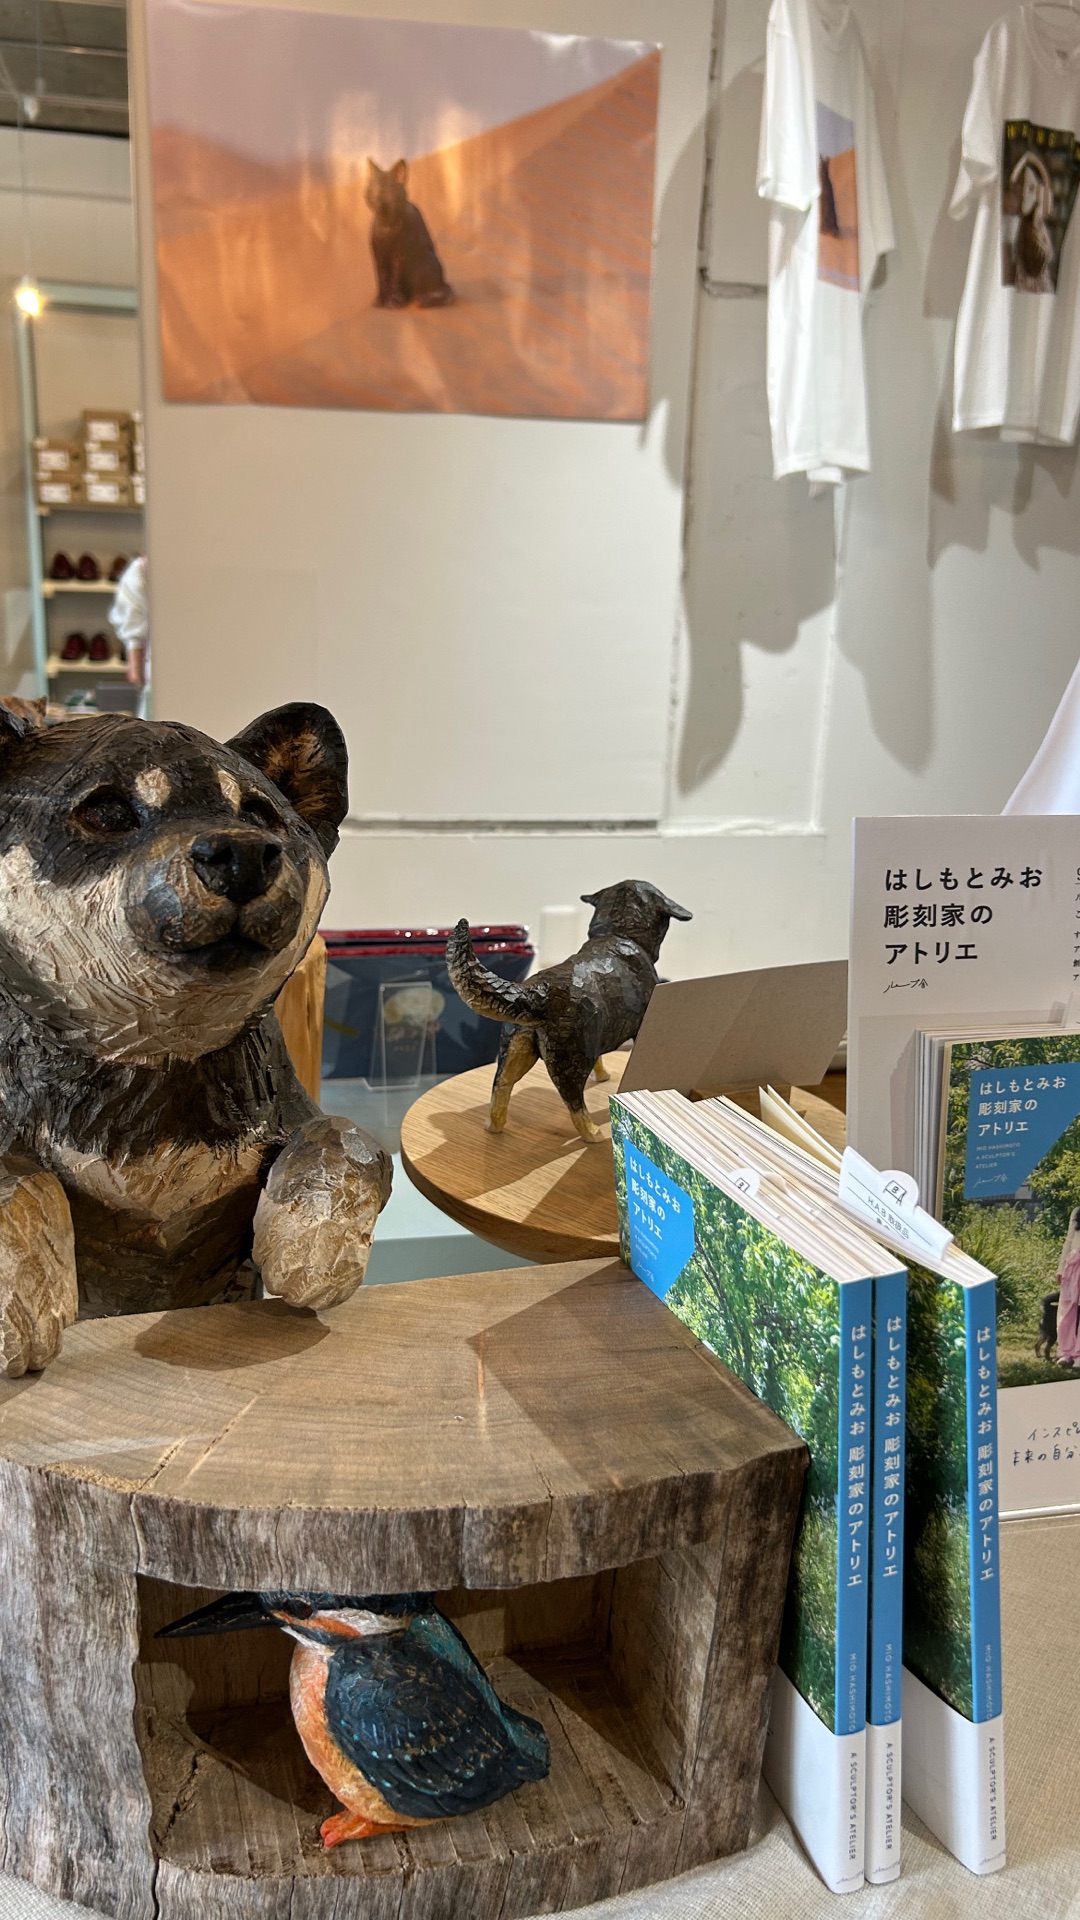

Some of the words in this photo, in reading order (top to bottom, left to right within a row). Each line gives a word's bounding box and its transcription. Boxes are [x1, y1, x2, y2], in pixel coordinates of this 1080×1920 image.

[885, 866, 1043, 891] はしもとみお
[883, 903, 993, 929] 彫刻家の
[884, 941, 978, 965] アトリエ
[978, 1099, 1038, 1116] 彫刻家の
[979, 1076, 1067, 1095] はしもとみお
[978, 1121, 1029, 1137] アトリエ
[629, 1156, 681, 1214] はしもとみお
[631, 1177, 666, 1221] 彫刻家の
[633, 1201, 663, 1240] アトリエ
[850, 1325, 867, 1435] はしもとみお
[885, 1316, 902, 1426] はしもとみお
[976, 1326, 993, 1435] はしもとみお
[847, 1444, 866, 1587] 彫刻家のアトリエ
[882, 1436, 901, 1577] 彫刻家のアトリエ
[977, 1443, 994, 1581] 彫刻家のアトリエ
[849, 1675, 857, 1732] HASHIMOTO
[884, 1666, 892, 1722] HASHIMOTO
[849, 1823, 857, 1860] ATELIER
